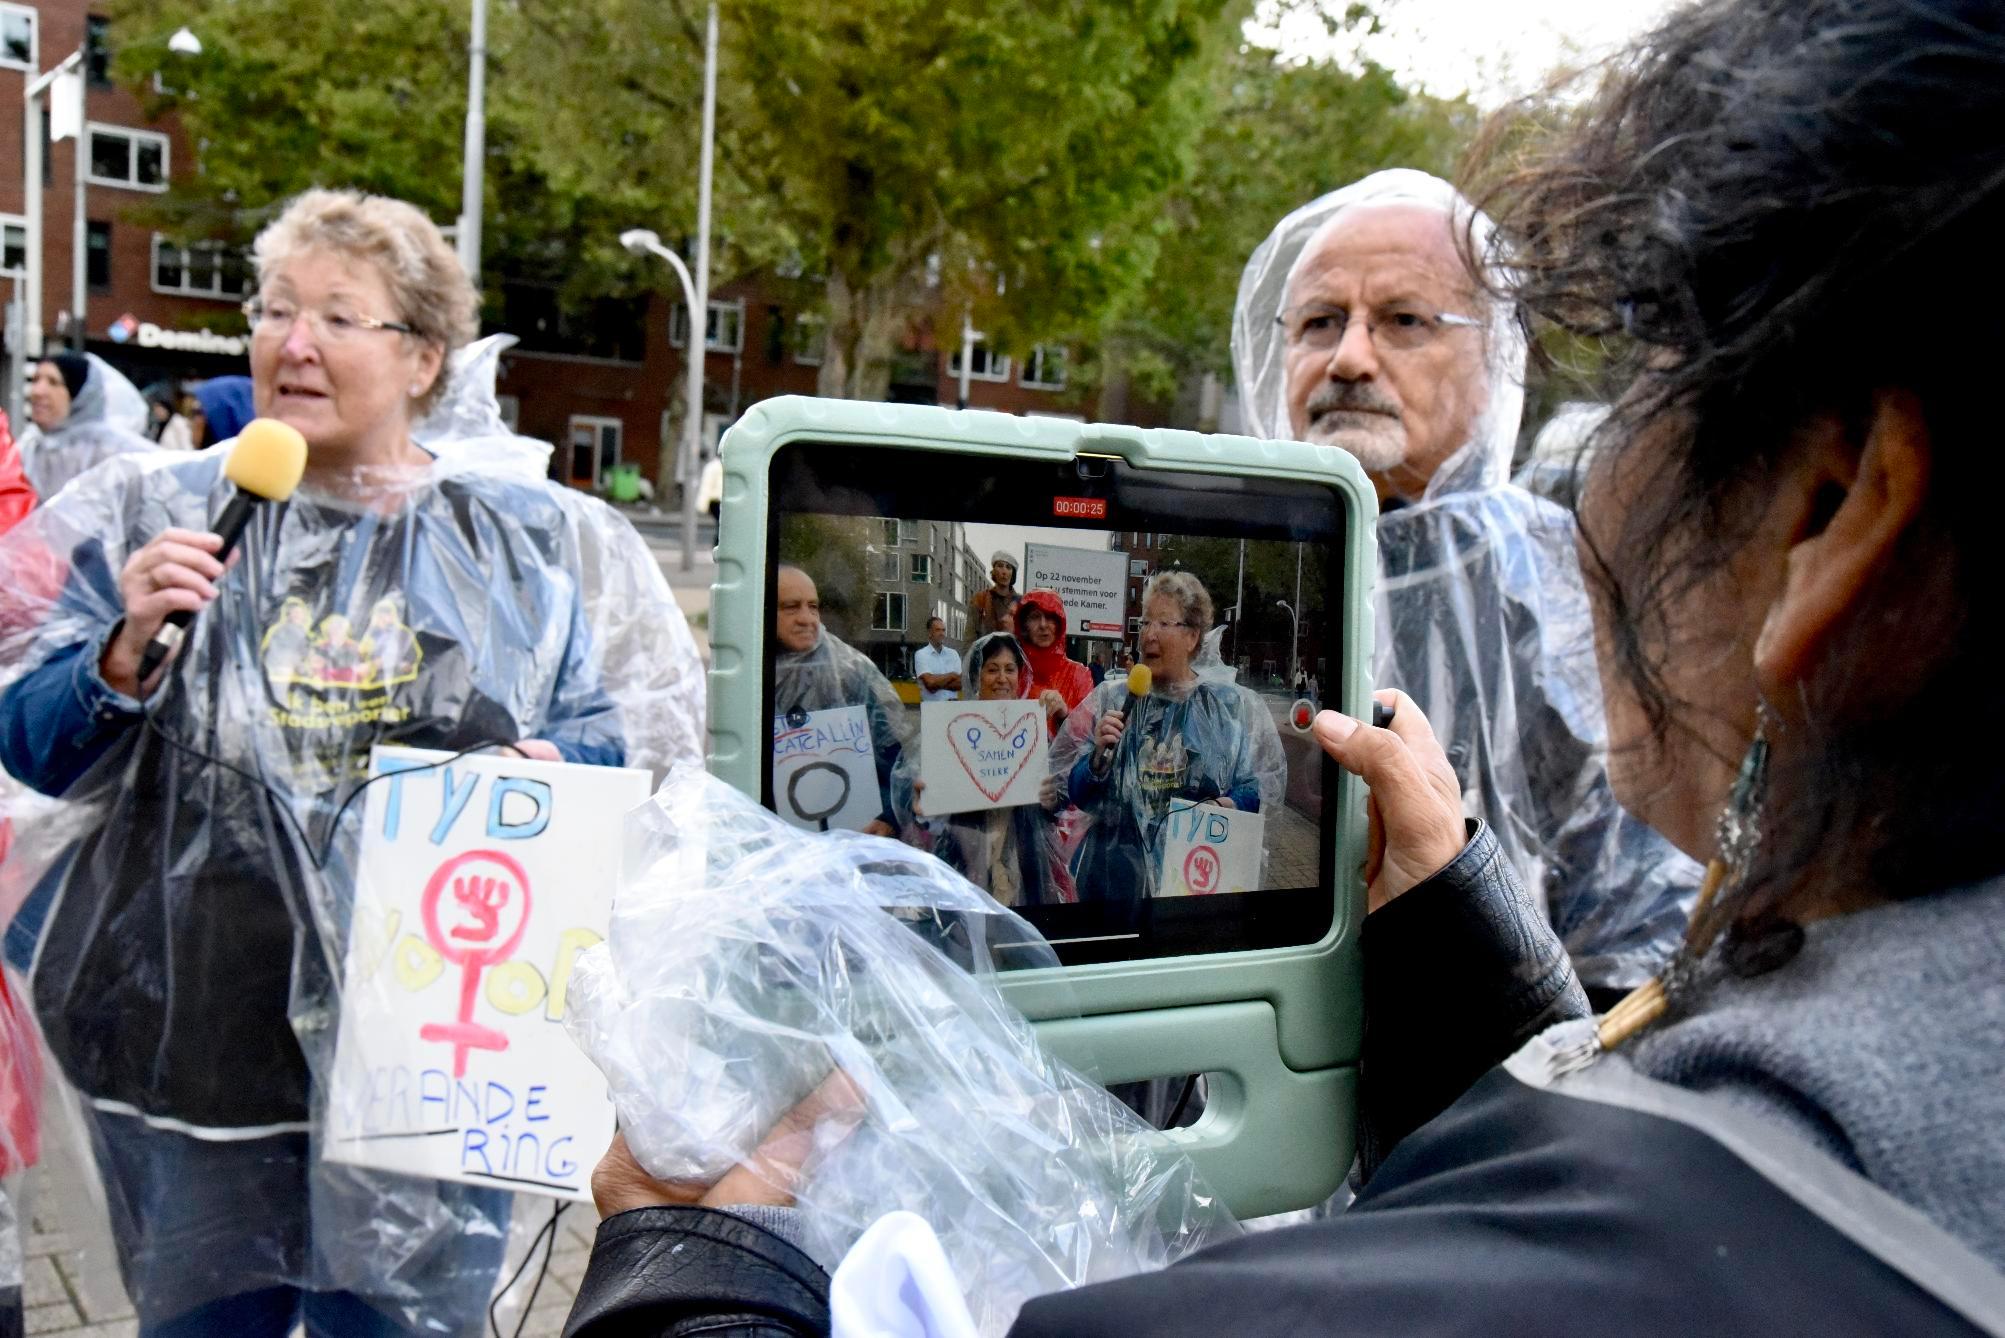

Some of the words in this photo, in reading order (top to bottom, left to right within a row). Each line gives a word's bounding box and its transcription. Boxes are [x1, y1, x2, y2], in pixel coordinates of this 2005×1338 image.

[138, 323, 250, 355] Domino'
[1056, 501, 1103, 514] 00:00:25
[1035, 571, 1048, 580] Op
[1050, 572, 1060, 580] 22
[1061, 575, 1102, 584] november
[1062, 586, 1098, 596] stemmen
[1080, 600, 1108, 610] Kamer.
[375, 757, 552, 846] TYD
